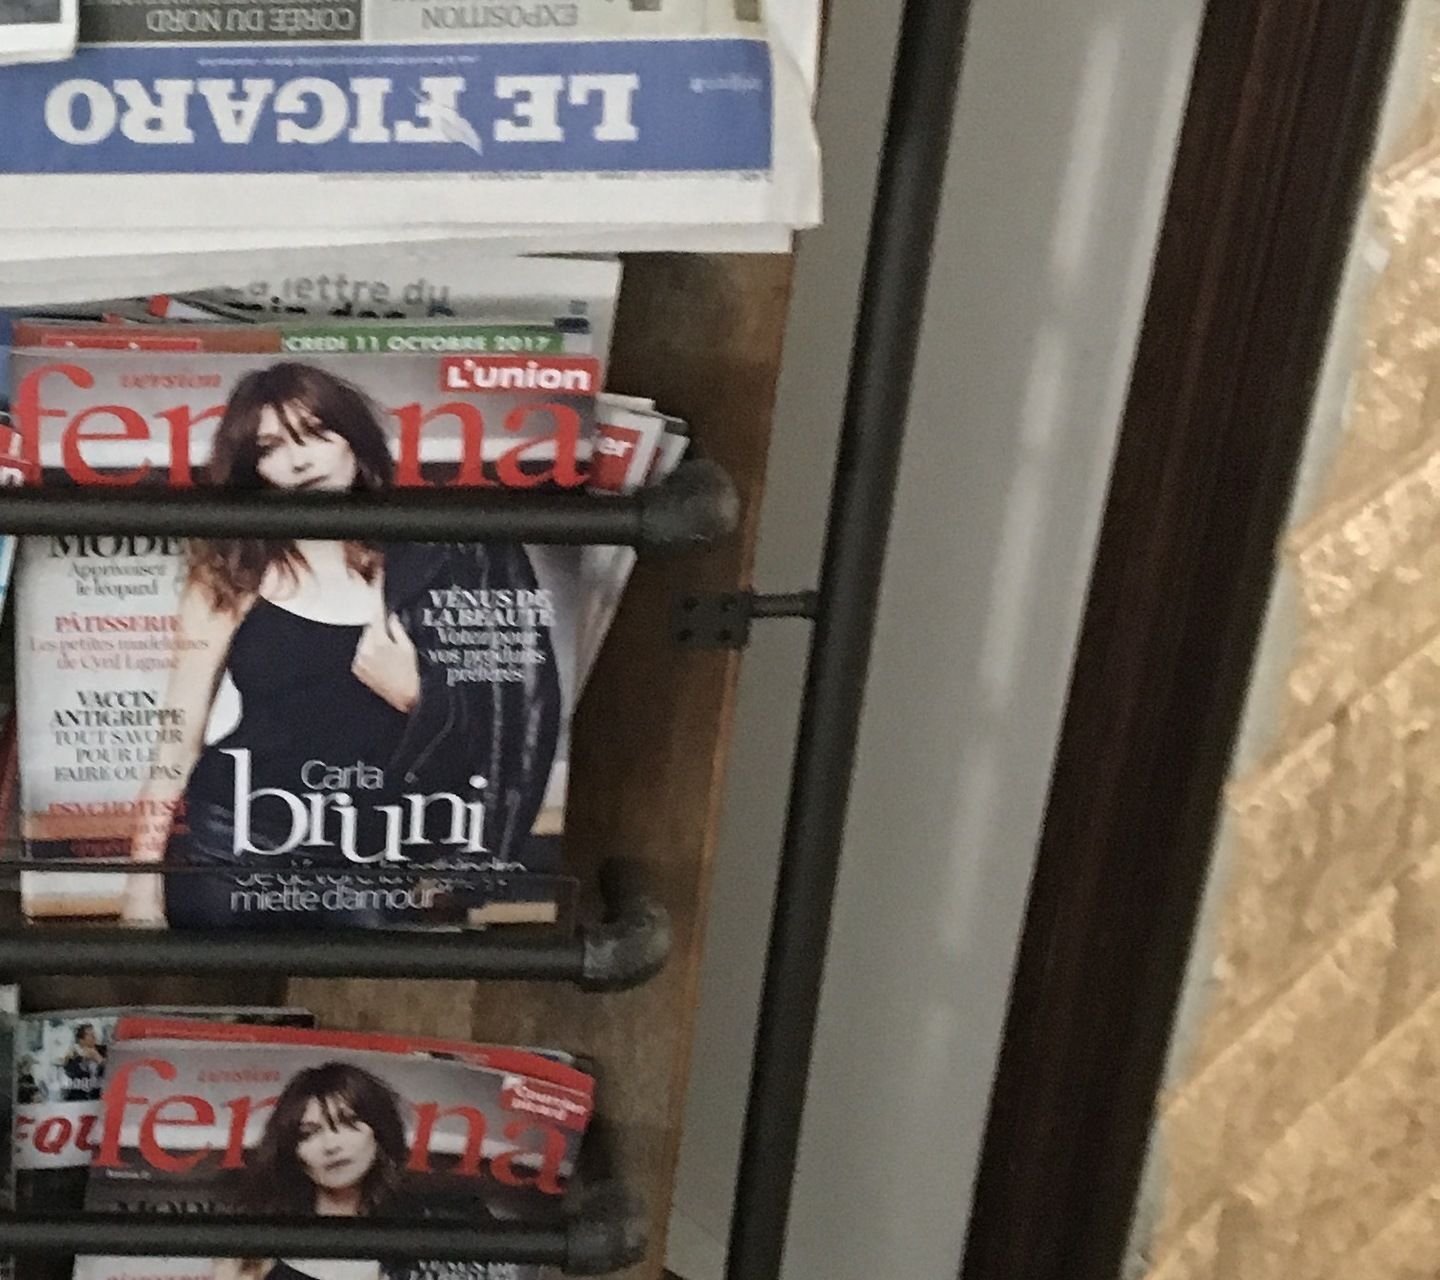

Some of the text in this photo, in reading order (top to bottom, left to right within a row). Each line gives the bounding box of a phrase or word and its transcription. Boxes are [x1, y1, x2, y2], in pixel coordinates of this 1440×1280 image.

[145, 7, 357, 36] CORÉE DU NORD
[421, 3, 580, 30] EXPOSITION
[42, 74, 640, 146] LE FIGARO
[402, 277, 452, 306] du
[356, 334, 381, 352] 11
[387, 334, 486, 352] OCTOBRE
[494, 334, 551, 352] 2017
[447, 359, 592, 391] L'union
[11, 363, 592, 489] fena
[76, 689, 159, 707] VACCIN
[51, 708, 187, 728] ANTIGRIPPE
[52, 728, 184, 746] TOUT SAVOIR
[76, 747, 161, 763] POUR LE
[52, 765, 111, 782] FAIRE
[148, 764, 183, 780] PAS
[300, 758, 385, 791] Carla
[218, 747, 492, 864] bruni
[230, 885, 320, 913] miette
[92, 1058, 566, 1195] fena
